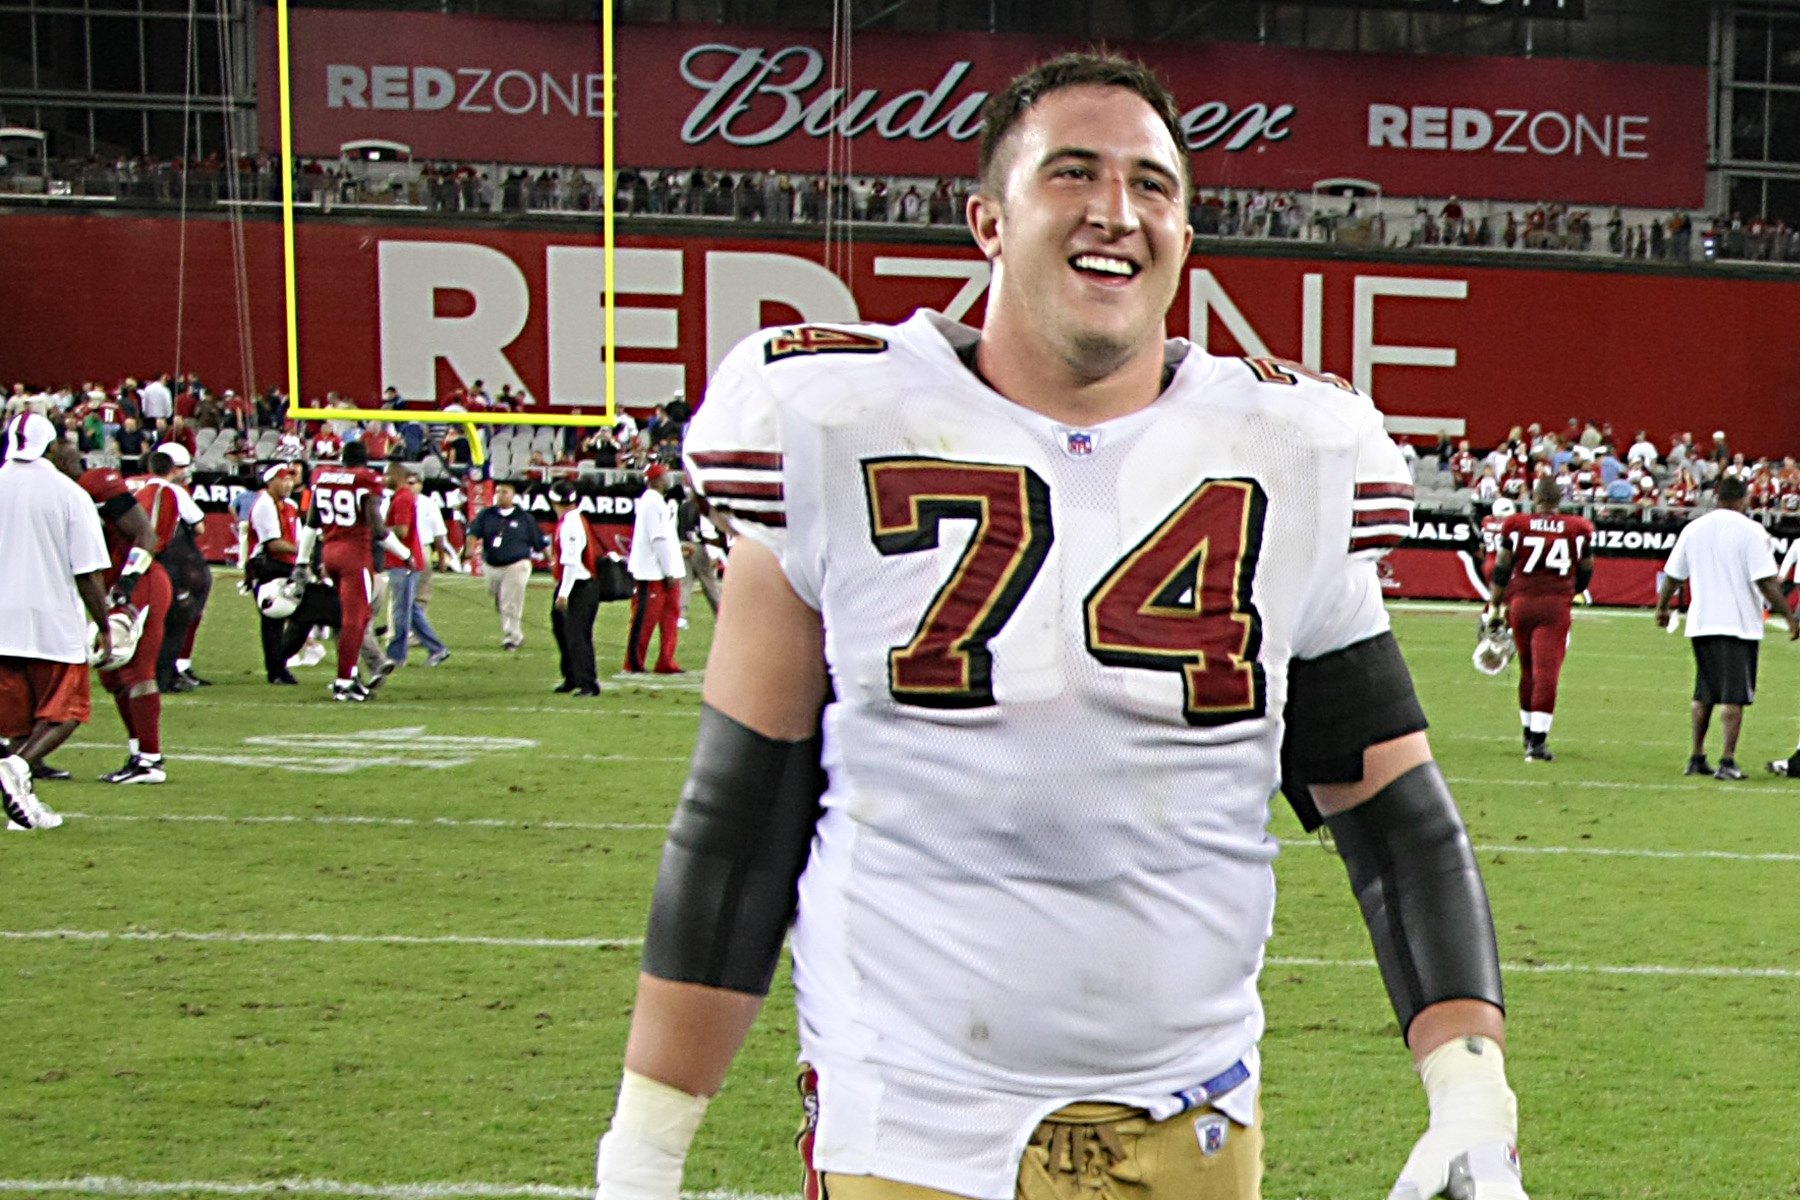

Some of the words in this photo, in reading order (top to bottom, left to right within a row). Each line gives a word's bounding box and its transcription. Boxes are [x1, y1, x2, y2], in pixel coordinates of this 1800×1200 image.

[326, 64, 619, 118] REDZONE
[679, 43, 1296, 152] Buder
[1367, 103, 1649, 159] REDZONE
[378, 240, 1469, 438] REDNE
[315, 487, 357, 528] 59
[1529, 518, 1566, 533] WELLS
[1522, 536, 1572, 577] 74
[858, 455, 1269, 727] 74
